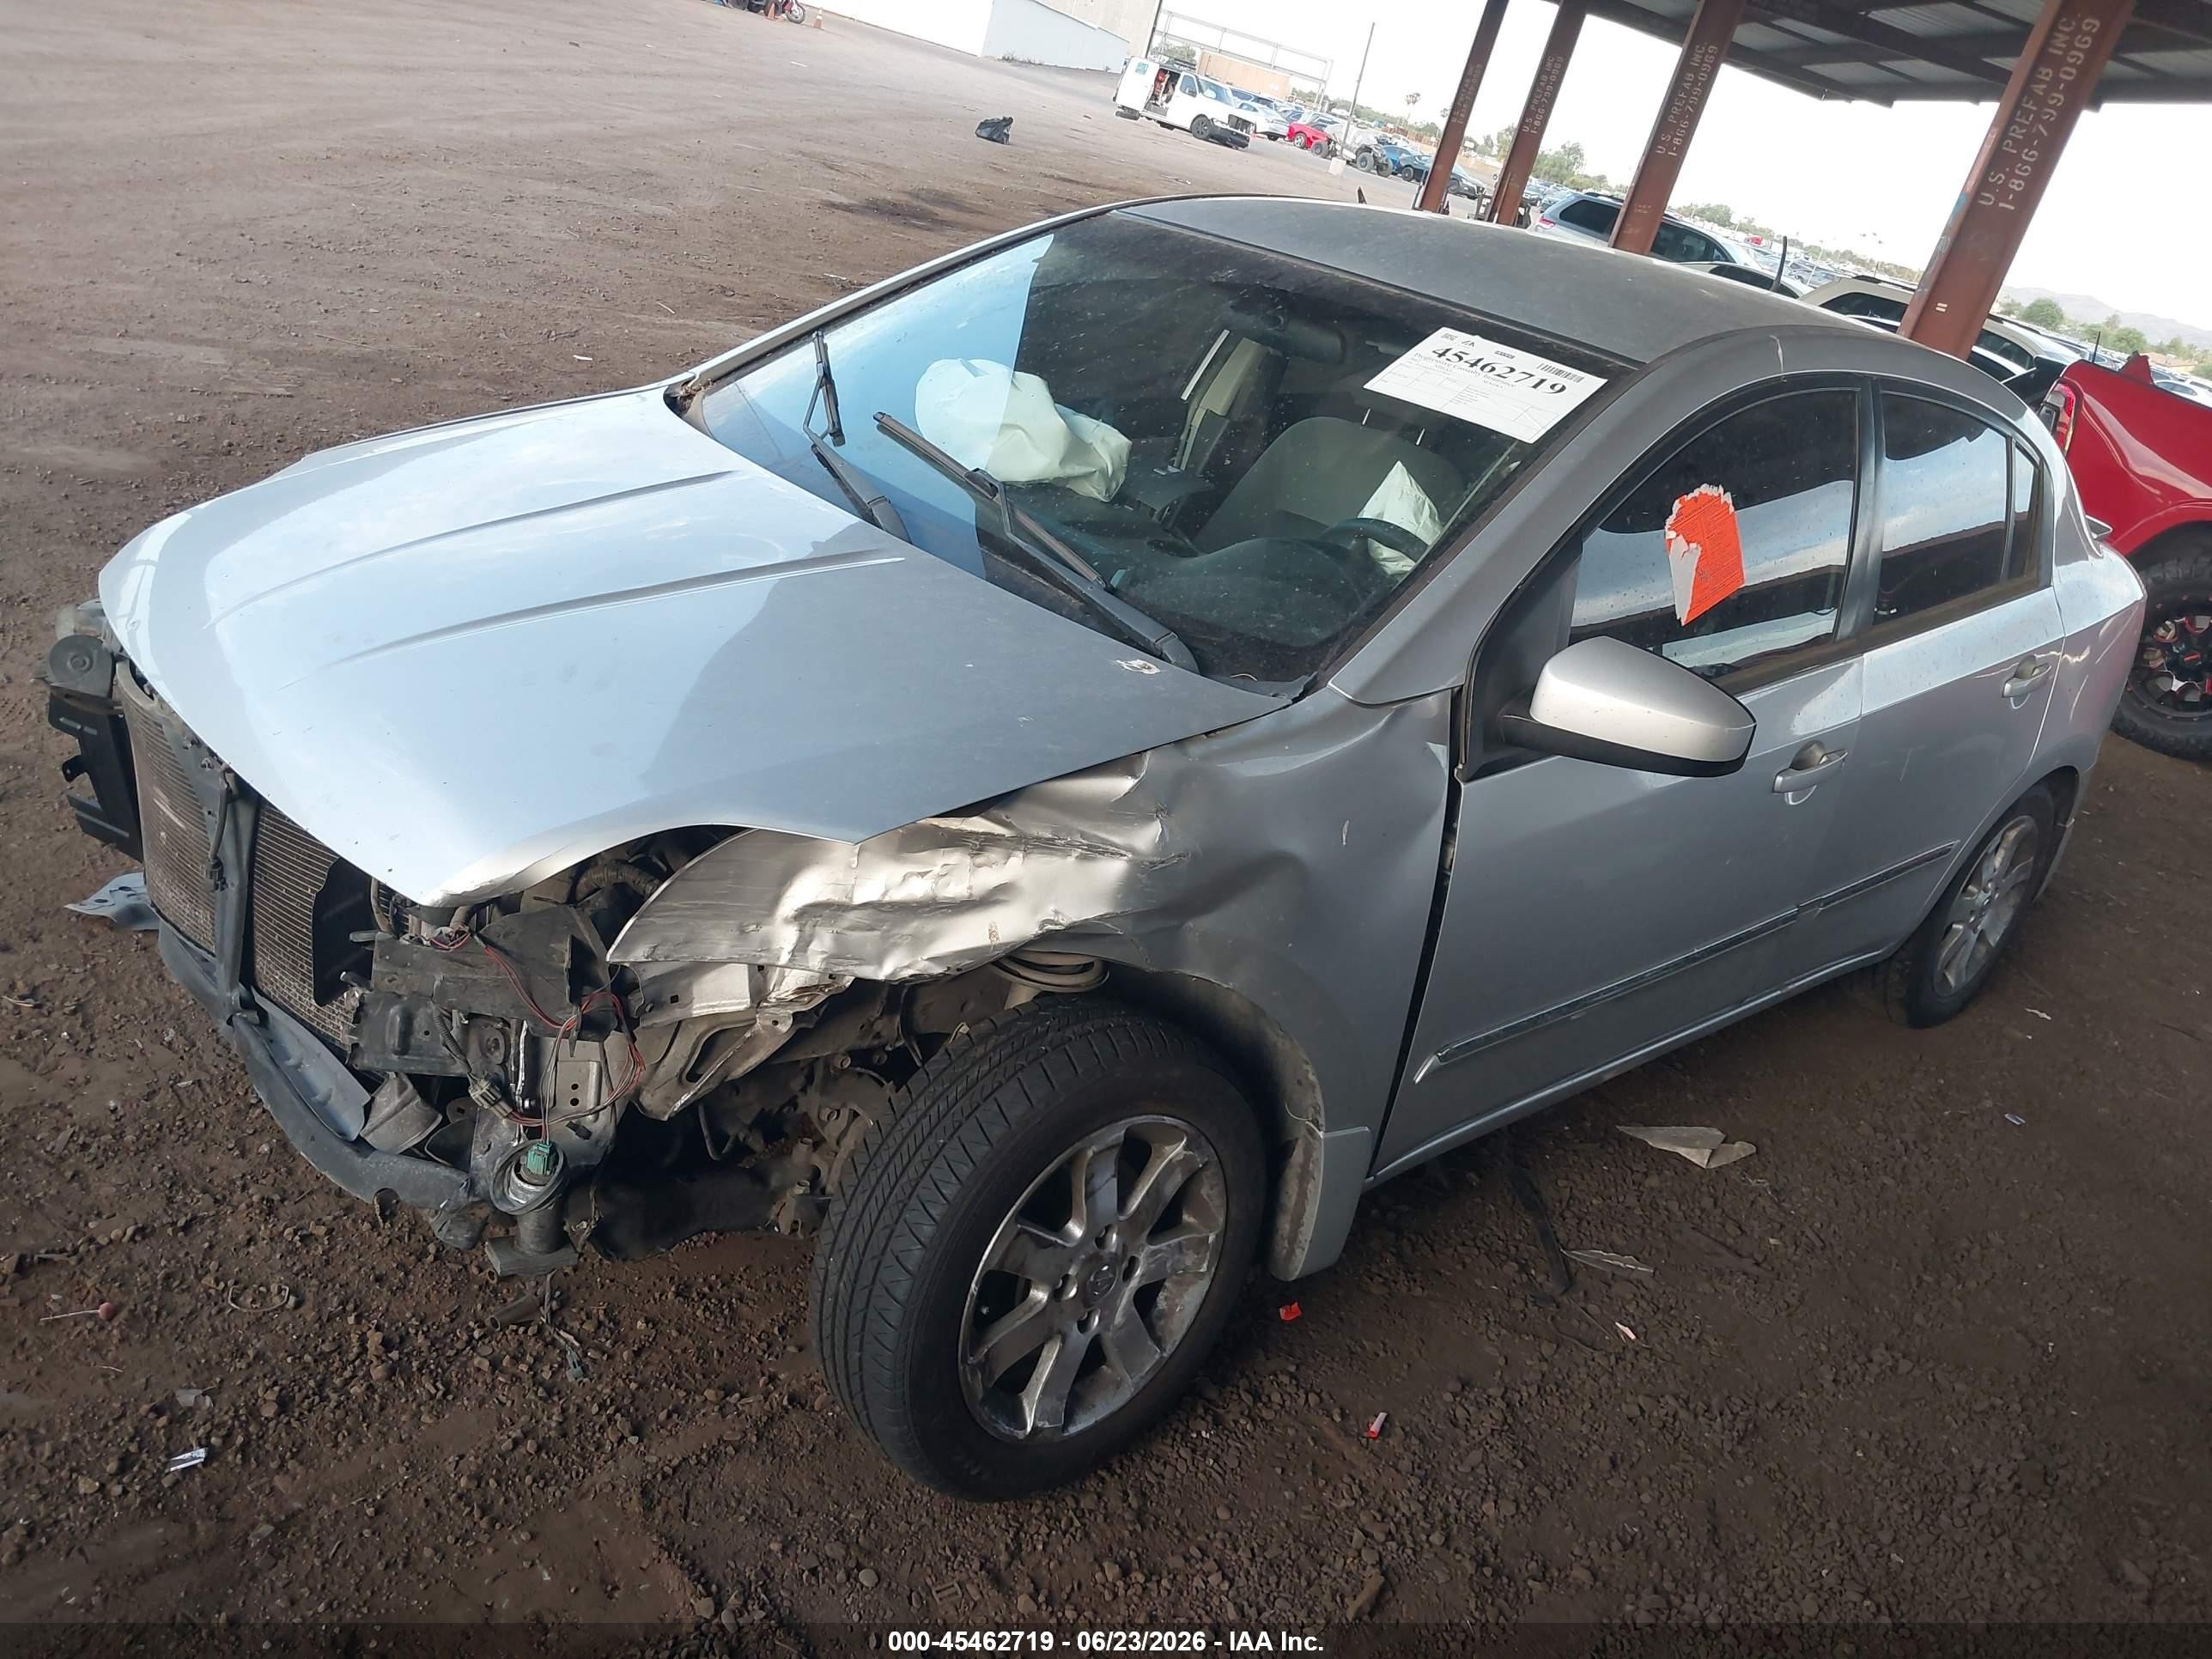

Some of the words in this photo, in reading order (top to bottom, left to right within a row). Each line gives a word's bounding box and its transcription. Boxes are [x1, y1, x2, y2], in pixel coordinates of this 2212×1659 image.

[1668, 72, 1695, 124] PREFAB
[1978, 167, 2009, 207] U.S.
[2002, 67, 2053, 154] PREFAB
[2047, 13, 2081, 56] INC.
[1998, 16, 2101, 210] 1-866-799-0969
[1432, 347, 1567, 394] 45462719
